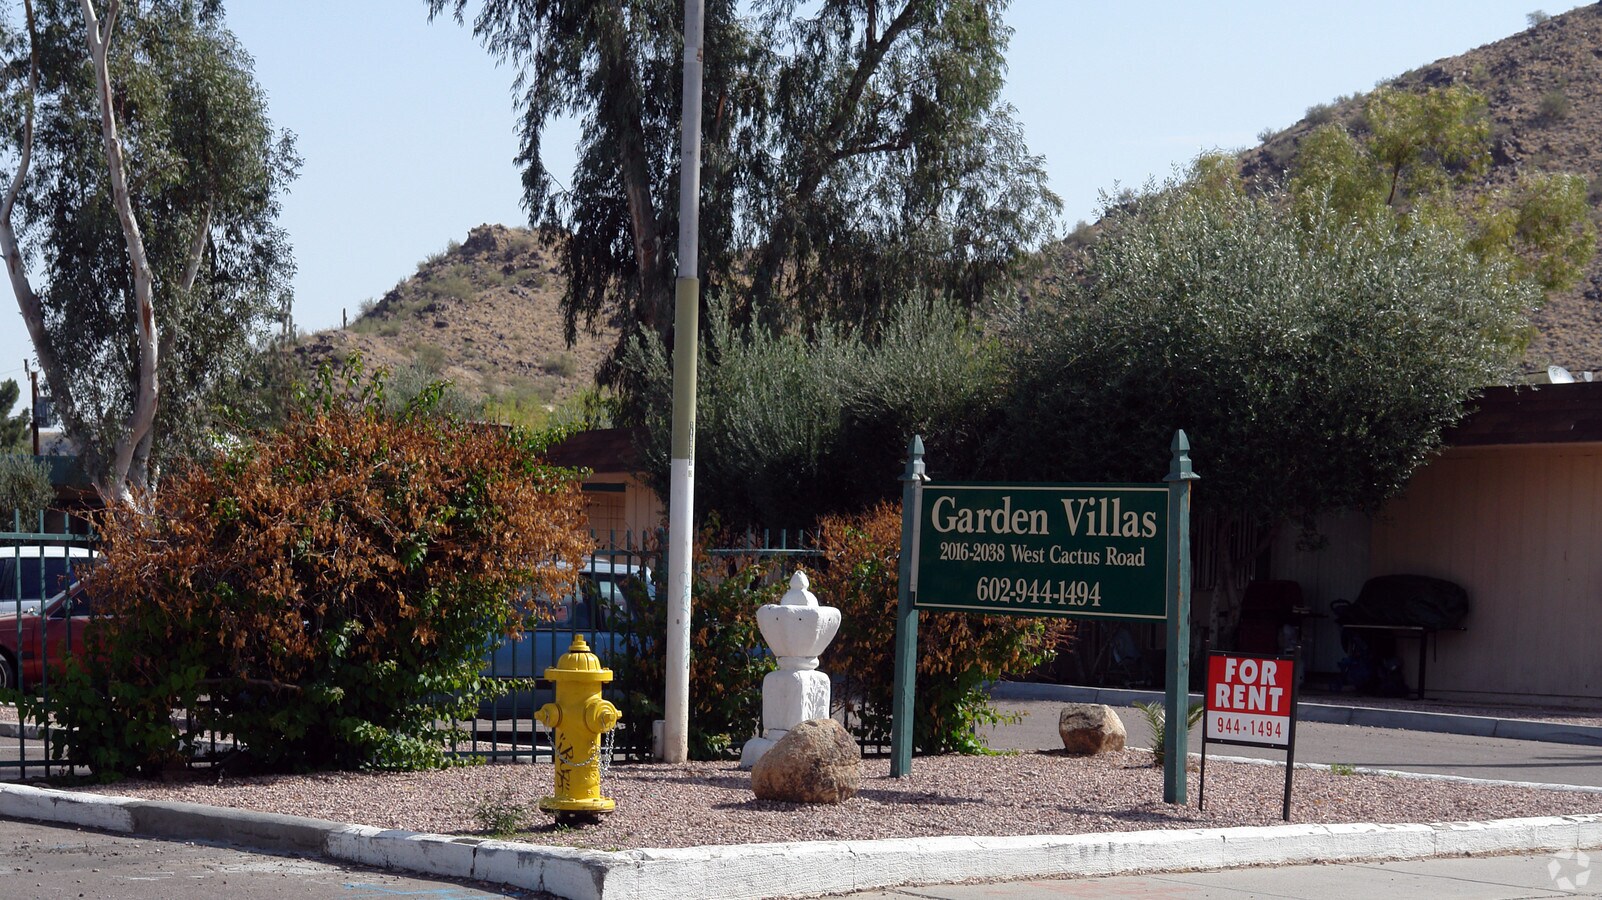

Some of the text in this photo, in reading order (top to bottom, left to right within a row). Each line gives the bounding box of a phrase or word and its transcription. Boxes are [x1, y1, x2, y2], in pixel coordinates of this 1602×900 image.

[931, 496, 1157, 538] Garden Villas
[940, 542, 1146, 567] 2016-2038 West Cactus Road
[976, 576, 1101, 607] 602-944-1494
[1225, 658, 1277, 686] FOR
[1215, 683, 1283, 712] RENT
